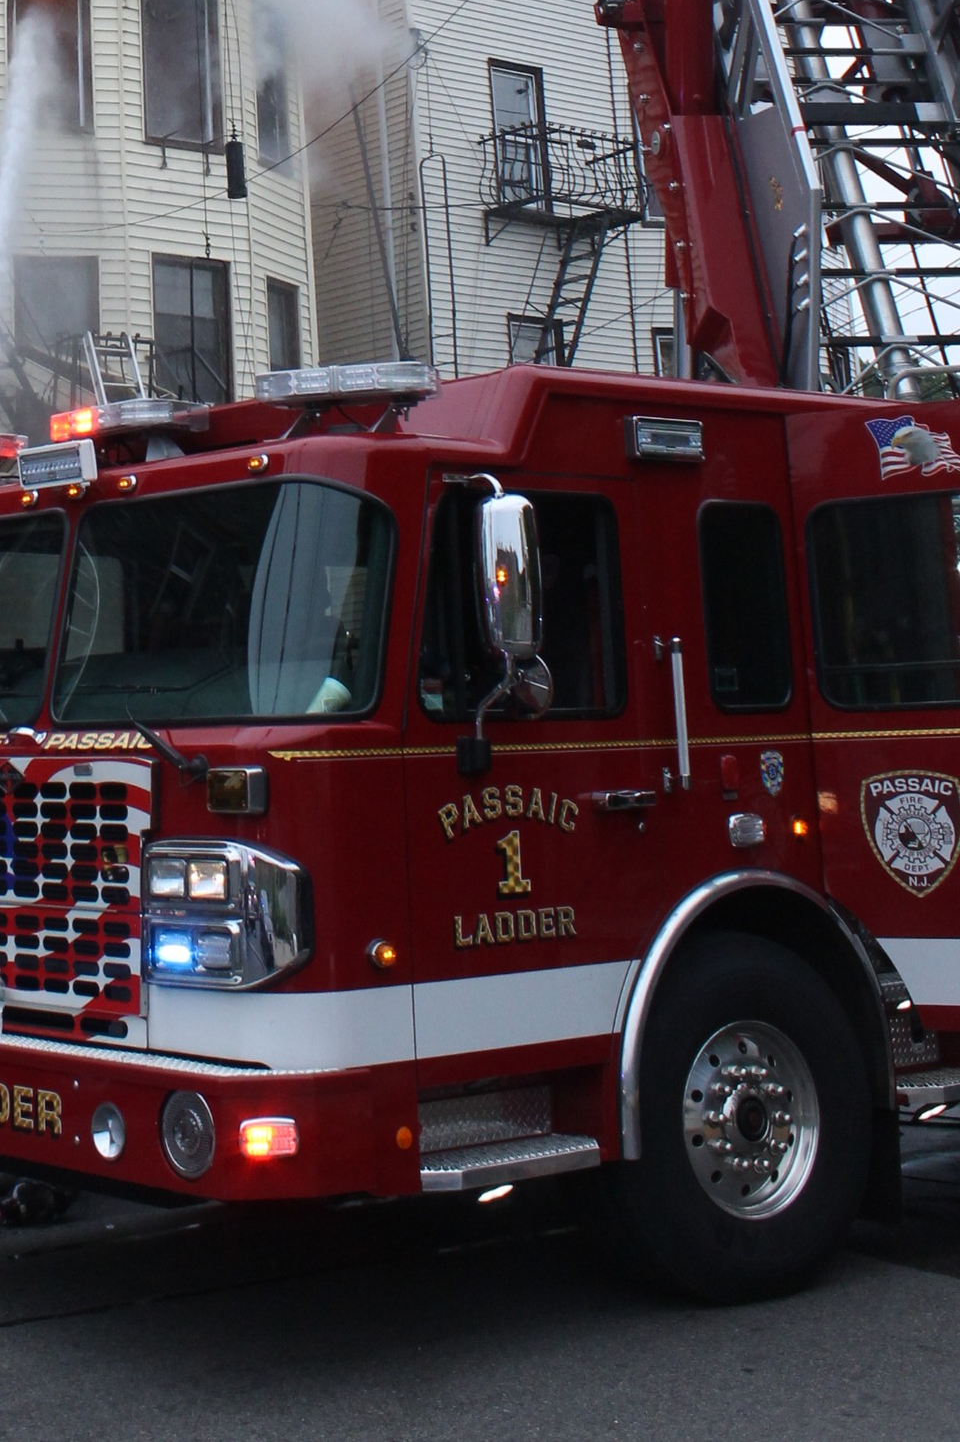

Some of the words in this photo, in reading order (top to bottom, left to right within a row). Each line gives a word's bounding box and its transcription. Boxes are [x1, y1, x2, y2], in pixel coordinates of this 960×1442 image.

[869, 778, 953, 797] PASSAIC
[900, 796, 924, 805] FIRE
[438, 785, 579, 839] PASSAIC
[497, 830, 531, 894] 1
[904, 863, 933, 872] DEPT.
[908, 876, 931, 887] N.J.
[454, 906, 577, 947] LADDER
